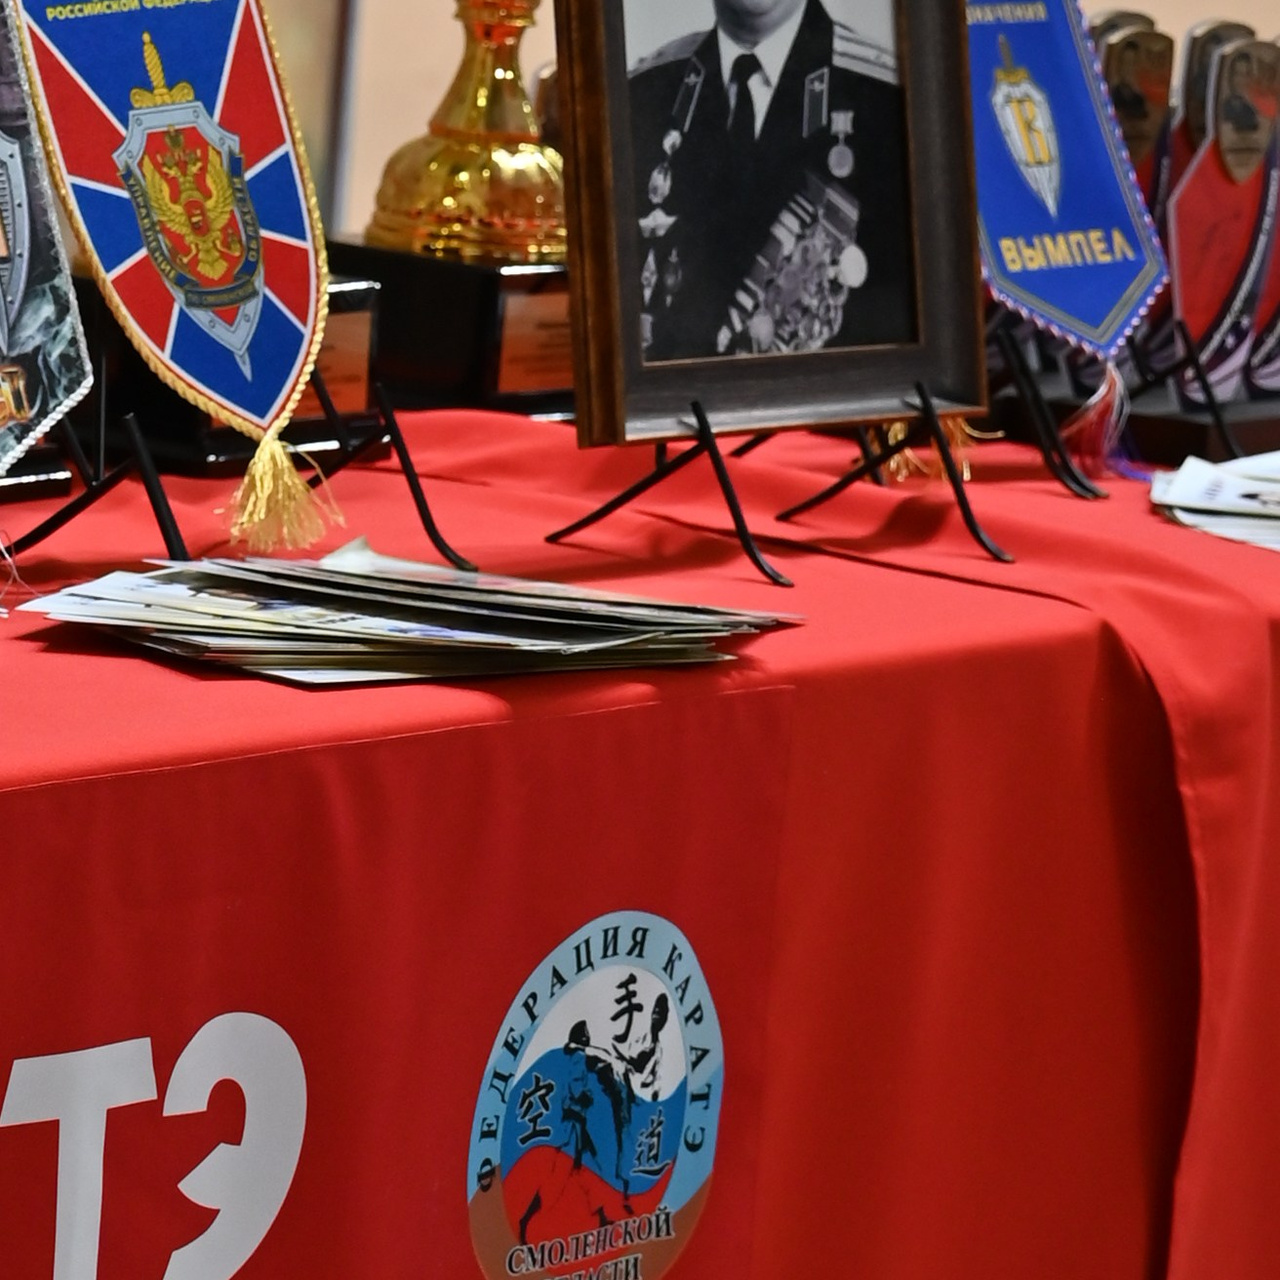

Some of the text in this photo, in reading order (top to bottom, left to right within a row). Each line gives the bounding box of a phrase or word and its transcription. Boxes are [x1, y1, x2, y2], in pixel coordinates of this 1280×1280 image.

[998, 227, 1137, 273] ВЫМПЕЛ
[477, 926, 713, 1192] ФЕДЕРАЦИЯ КАРАТЭ
[506, 1205, 675, 1276] СМОЛЕНСКОЙ
